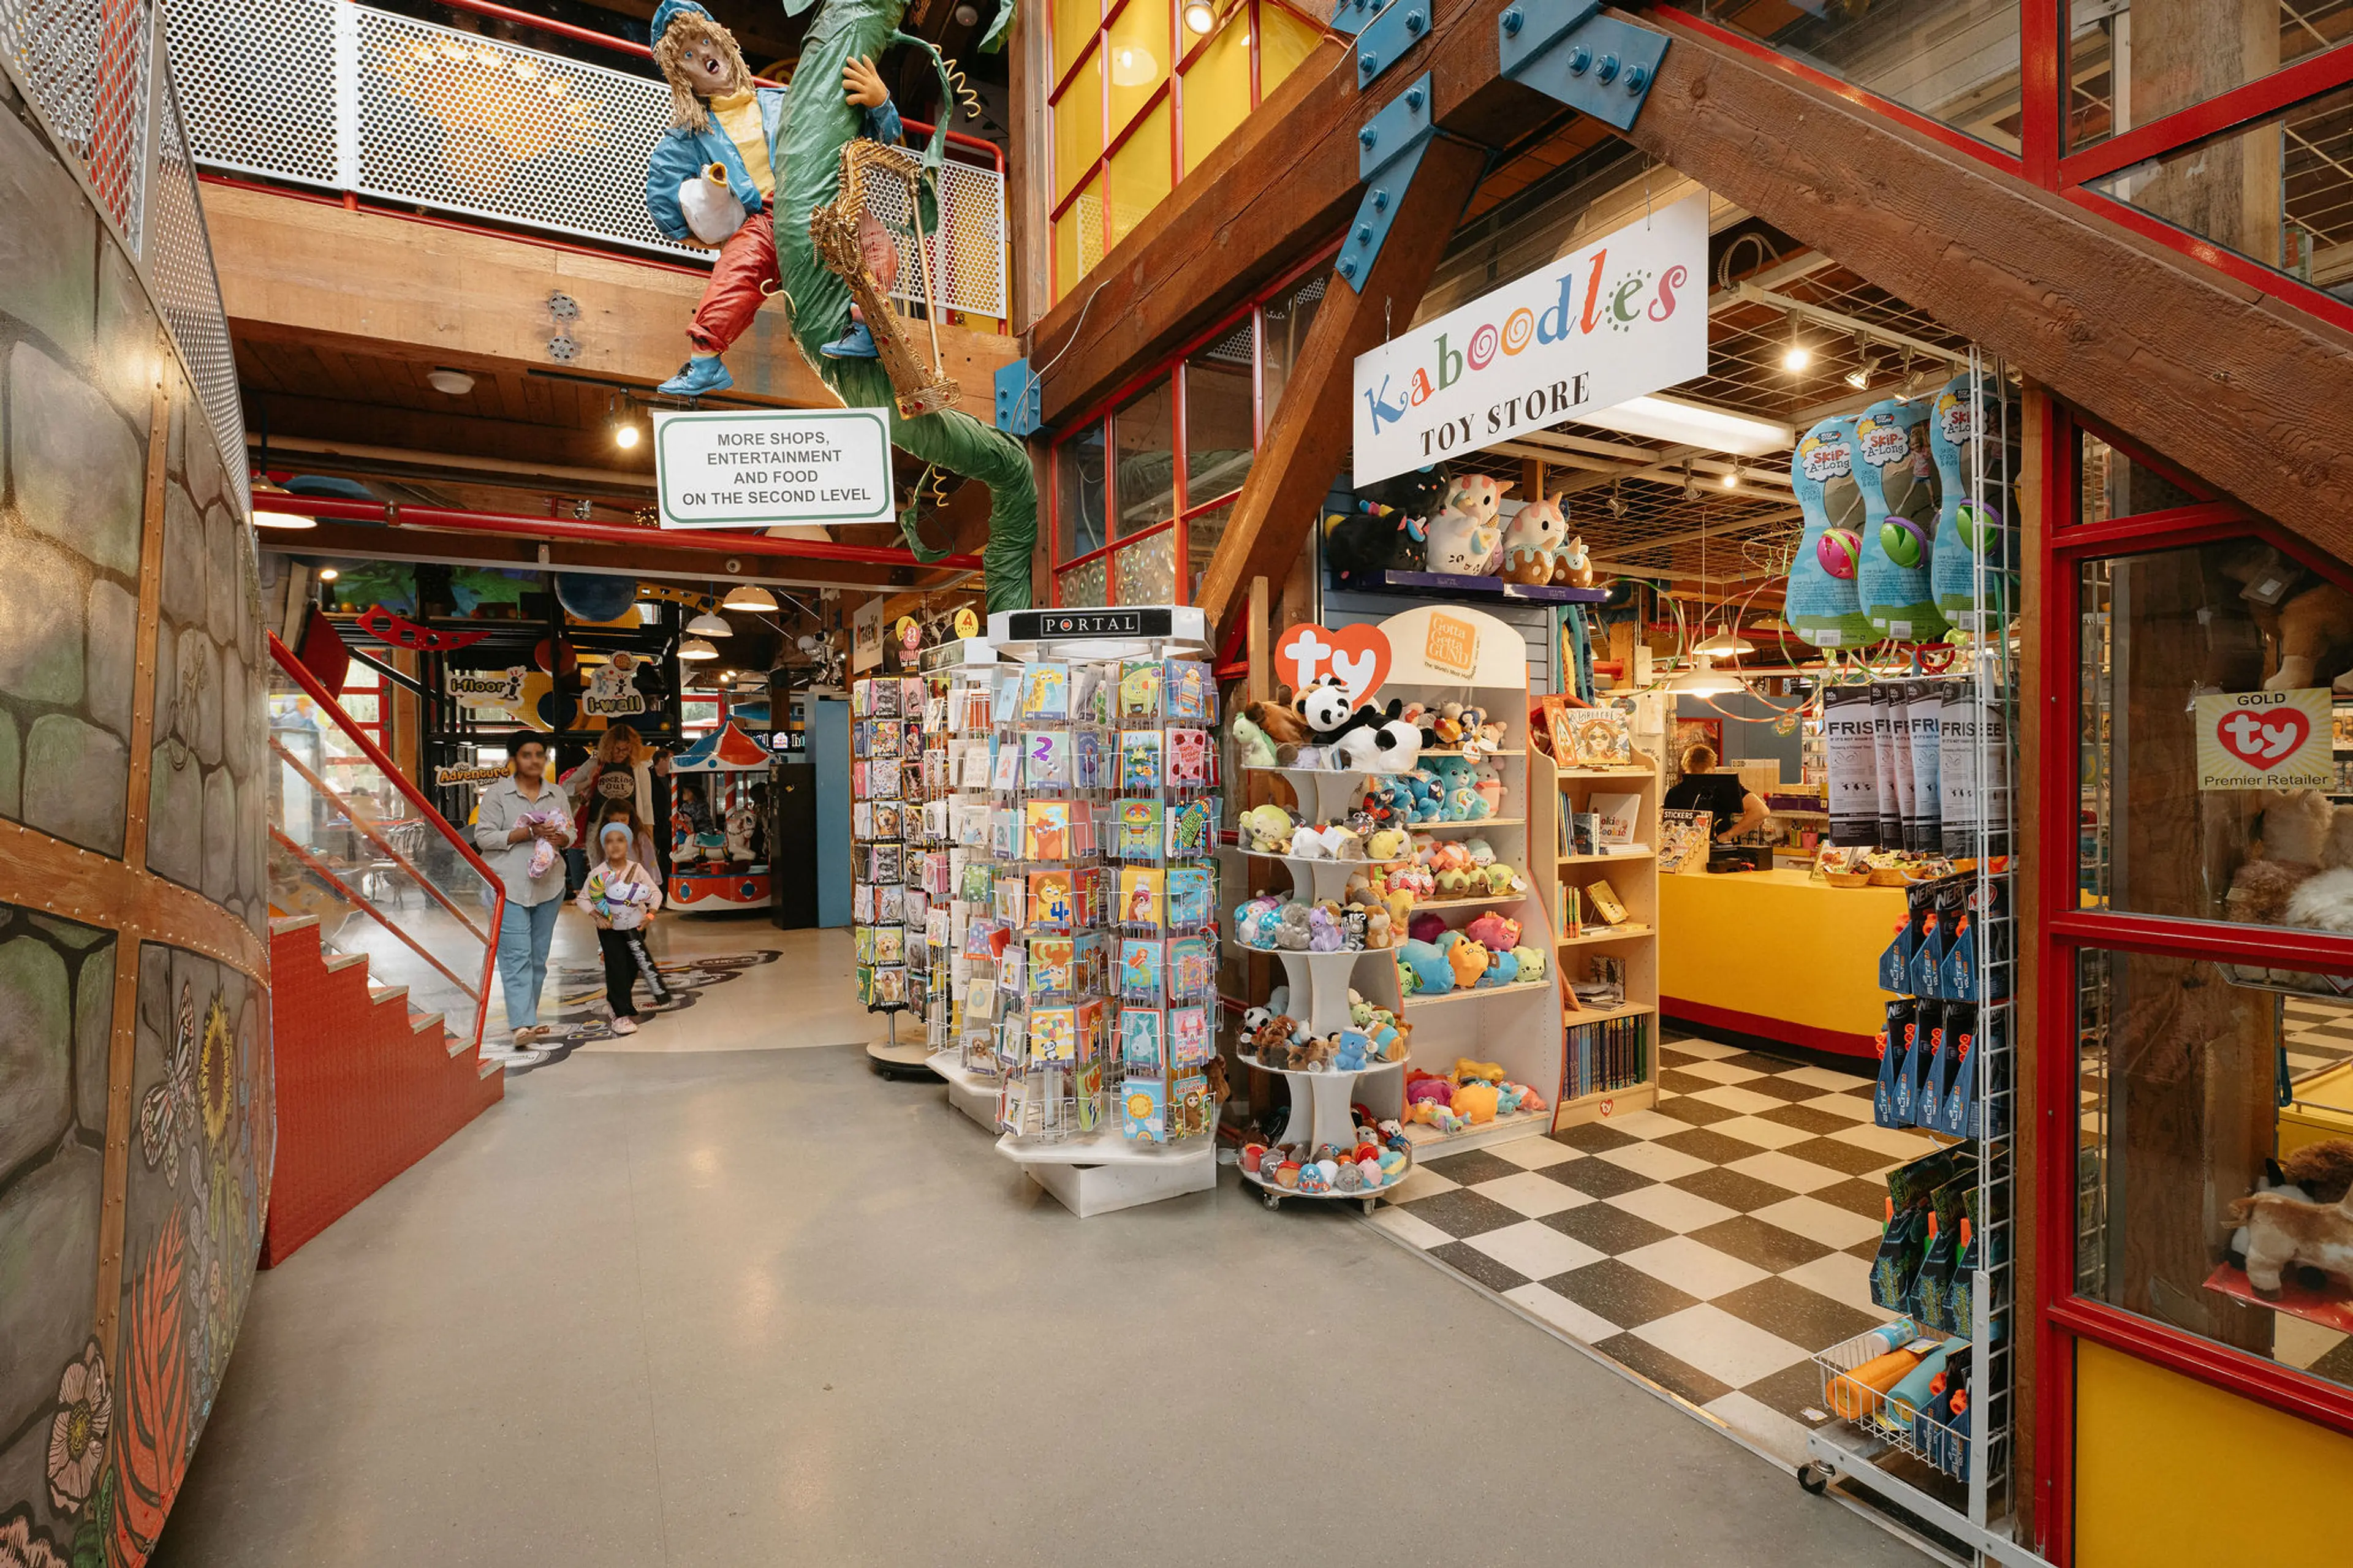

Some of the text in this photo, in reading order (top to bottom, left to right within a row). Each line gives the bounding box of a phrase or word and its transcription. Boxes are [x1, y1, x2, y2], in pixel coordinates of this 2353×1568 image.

[1363, 248, 1688, 436] Kaboodles
[1420, 371, 1590, 457] TOY STORE
[718, 431, 830, 447] MORE SHOPS,
[707, 449, 843, 466] ENTERTAINMENT
[733, 469, 819, 485] AND FOOD
[682, 488, 871, 506] ON THE SECOND LEVEL
[1045, 617, 1135, 632] PORTAL
[1433, 617, 1465, 640] Gotta
[1430, 642, 1468, 665] GUND
[1284, 629, 1376, 705] ty
[587, 695, 642, 713] i-wall
[2237, 693, 2286, 706] GOLD
[2224, 714, 2298, 759] ty
[1031, 737, 1053, 762] 2
[440, 766, 510, 783] Adventure
[2205, 774, 2328, 786] Premier Retailer
[1664, 811, 1694, 819] STICKERS
[1601, 1101, 1612, 1113] ty
